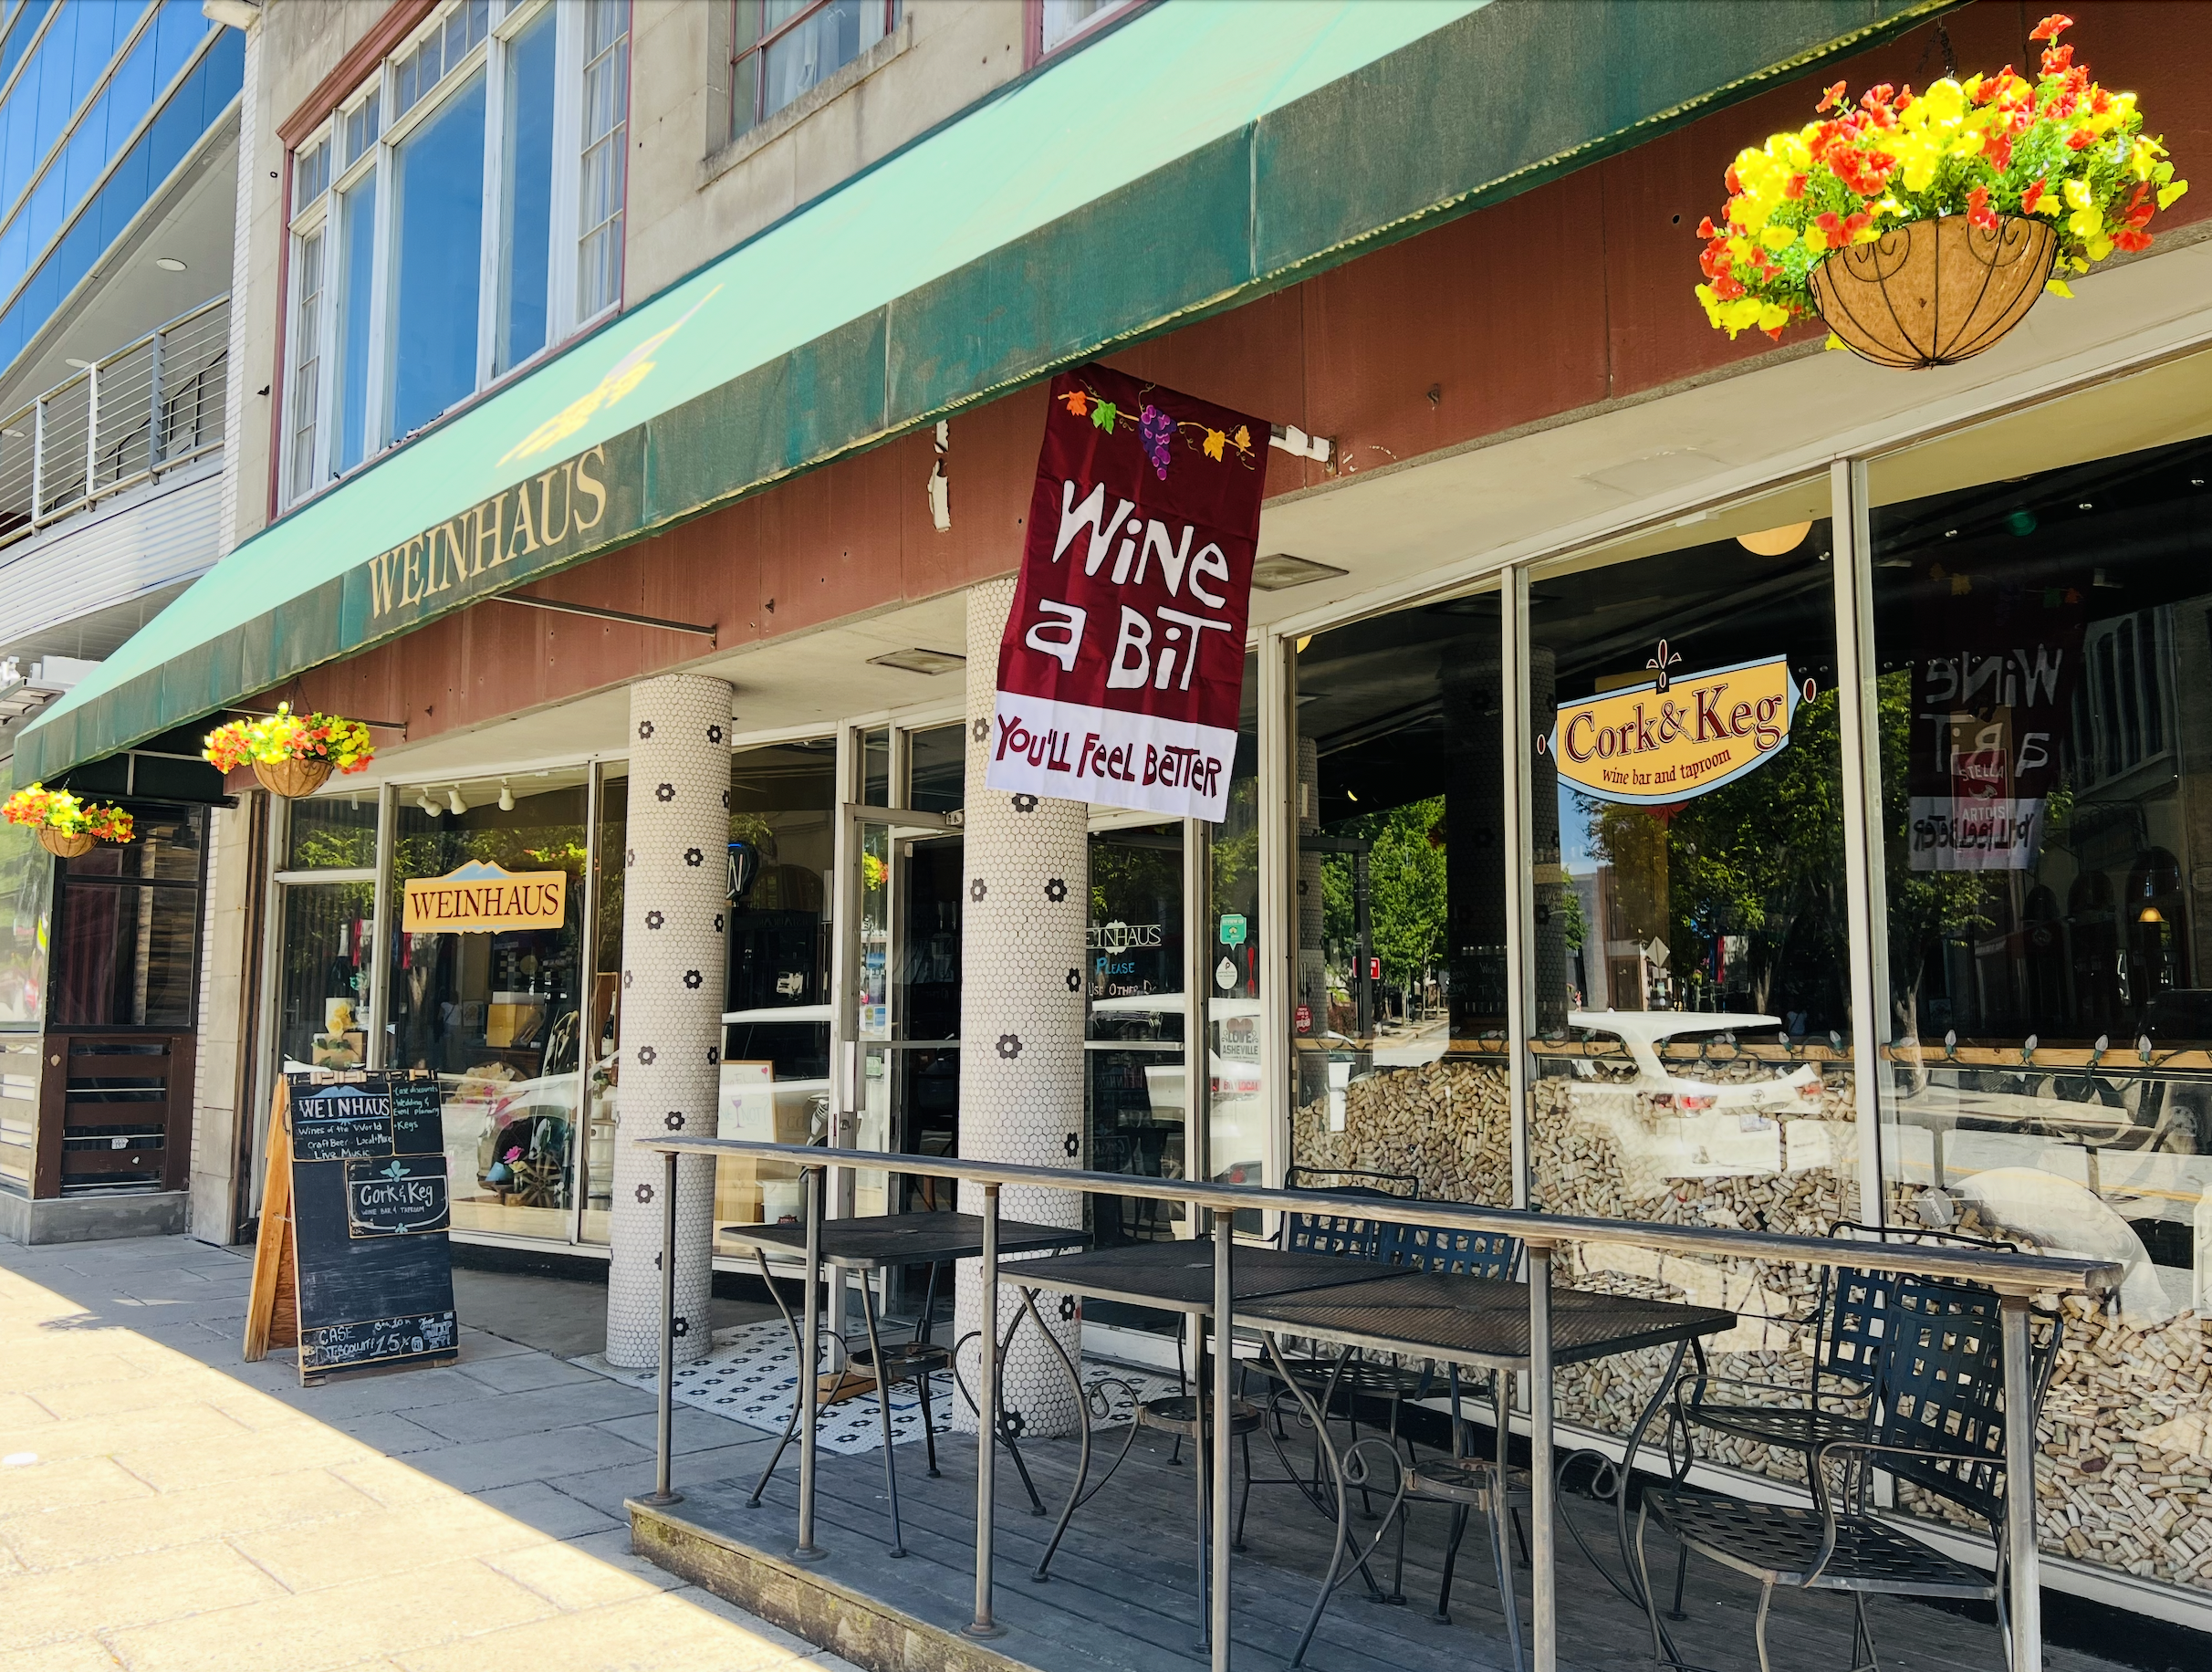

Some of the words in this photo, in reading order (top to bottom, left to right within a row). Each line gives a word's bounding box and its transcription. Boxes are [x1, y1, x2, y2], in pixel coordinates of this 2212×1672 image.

[368, 444, 606, 620] WEINHAUS
[1025, 598, 1089, 673] a
[1602, 767, 1630, 785] wine
[1633, 768, 1653, 786] bar
[1654, 765, 1677, 785] and
[1680, 748, 1732, 780] taproom
[1959, 763, 2004, 782] STELLA
[1962, 806, 2006, 821] ARTOIS
[411, 883, 558, 920] WEINHAUS
[1086, 926, 1162, 947] EINHAUS
[1227, 1029, 1252, 1044] LOVE
[1222, 1044, 1258, 1055] ASHEVILLE
[298, 1097, 391, 1119] WEINHAUS
[298, 1126, 325, 1135] Wines
[327, 1124, 334, 1134] of
[336, 1124, 349, 1133] the
[353, 1122, 382, 1132] World
[397, 1121, 419, 1133] Kegs
[330, 1138, 349, 1147] Beer
[314, 1150, 337, 1160] Live
[340, 1148, 370, 1158] Music
[319, 1325, 356, 1345] CASE
